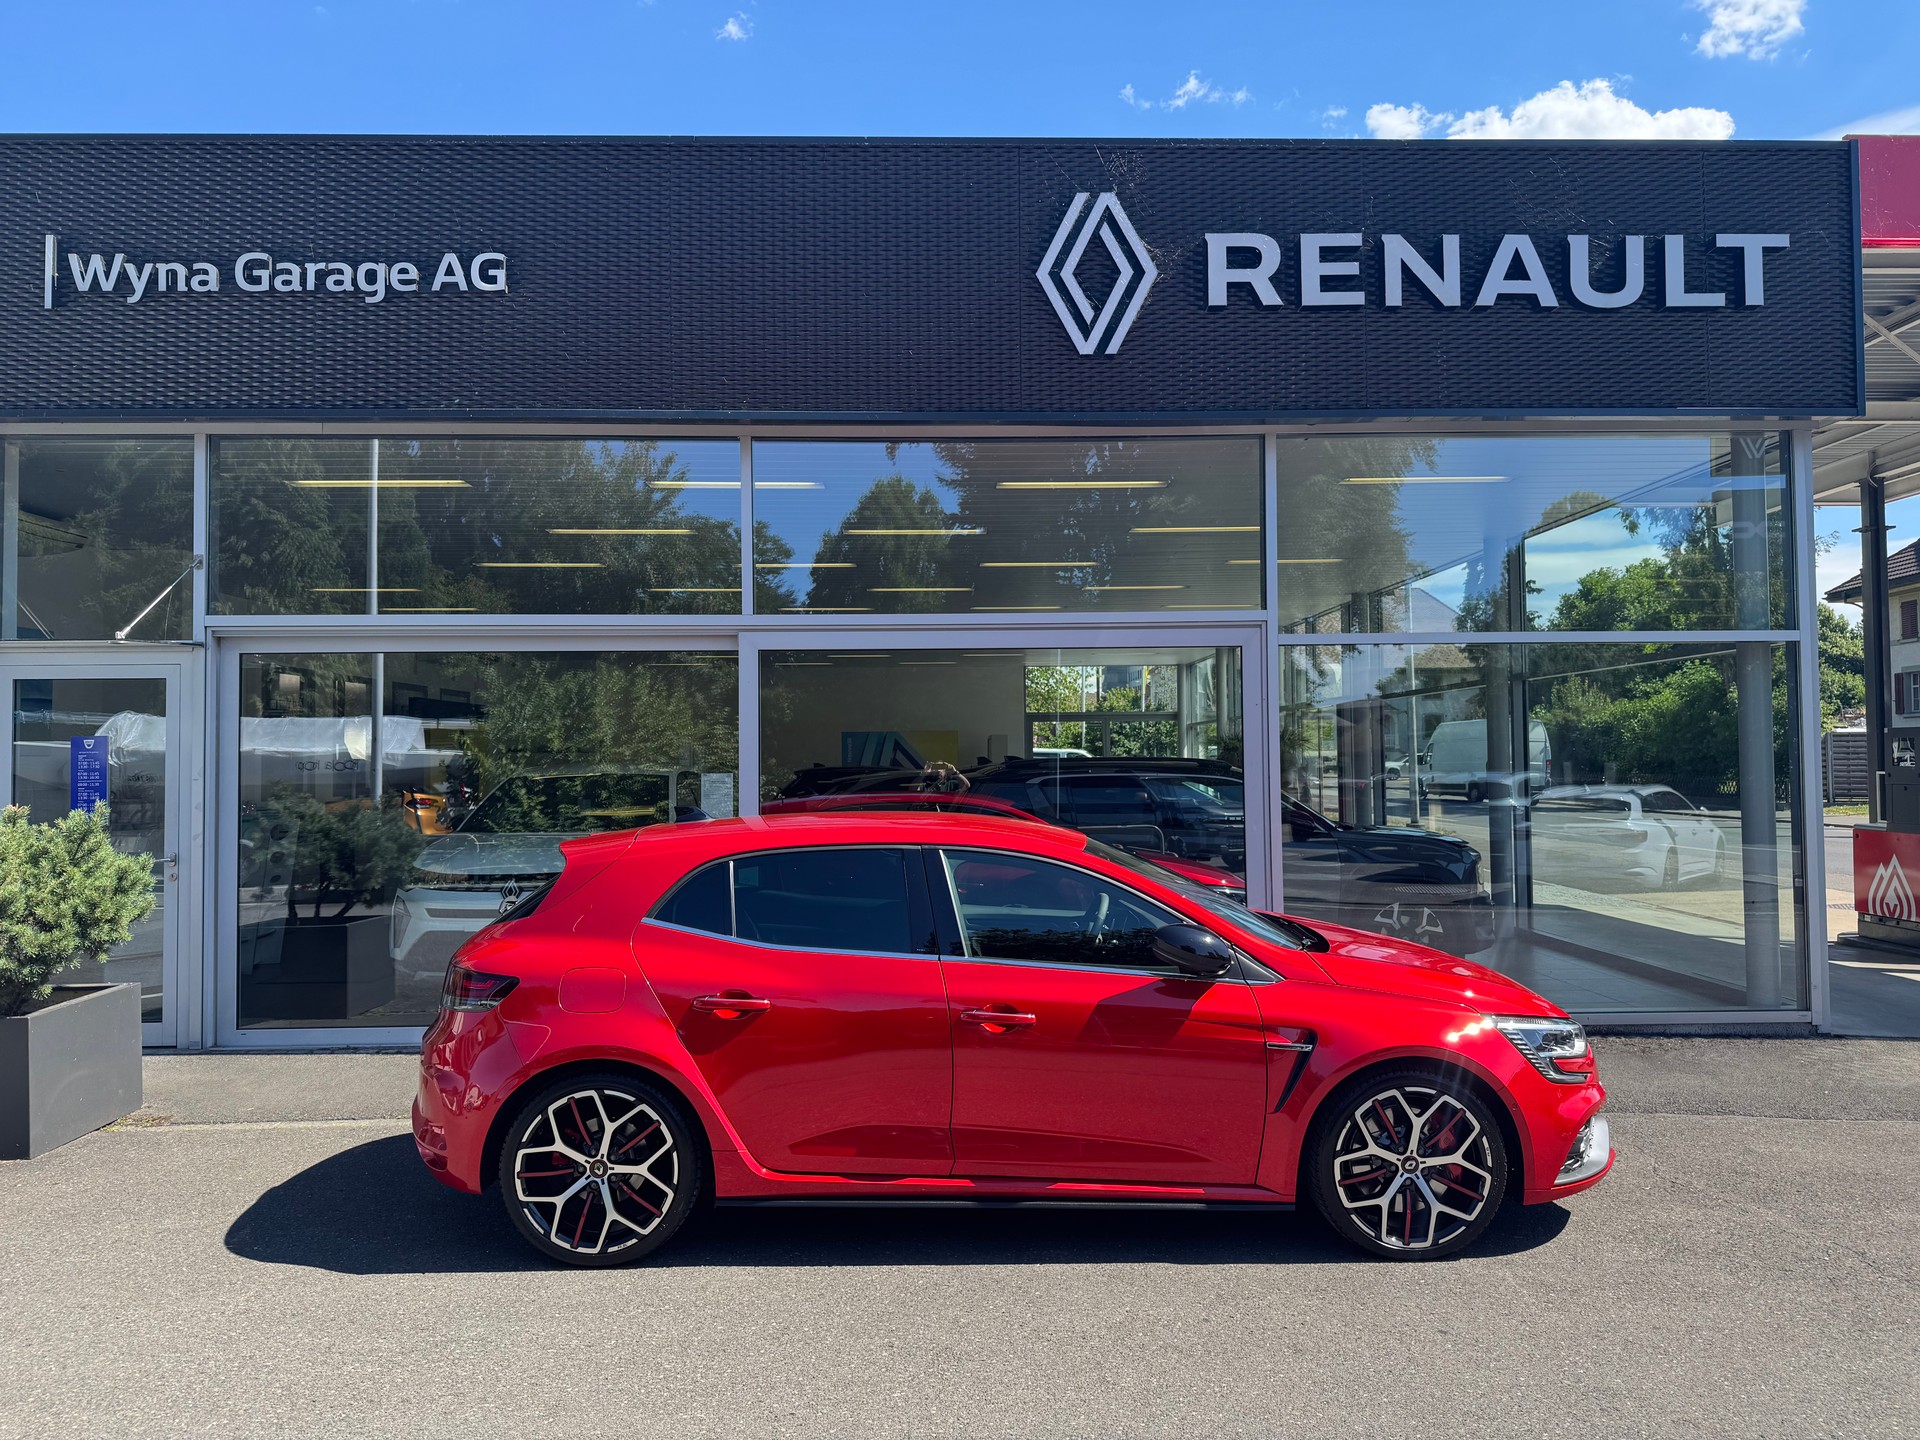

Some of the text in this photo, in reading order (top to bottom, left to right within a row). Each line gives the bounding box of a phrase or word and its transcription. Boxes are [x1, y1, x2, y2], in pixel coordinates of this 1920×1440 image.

[67, 252, 508, 304] Wyna Garage AG
[1204, 232, 1790, 309] RENAULT
